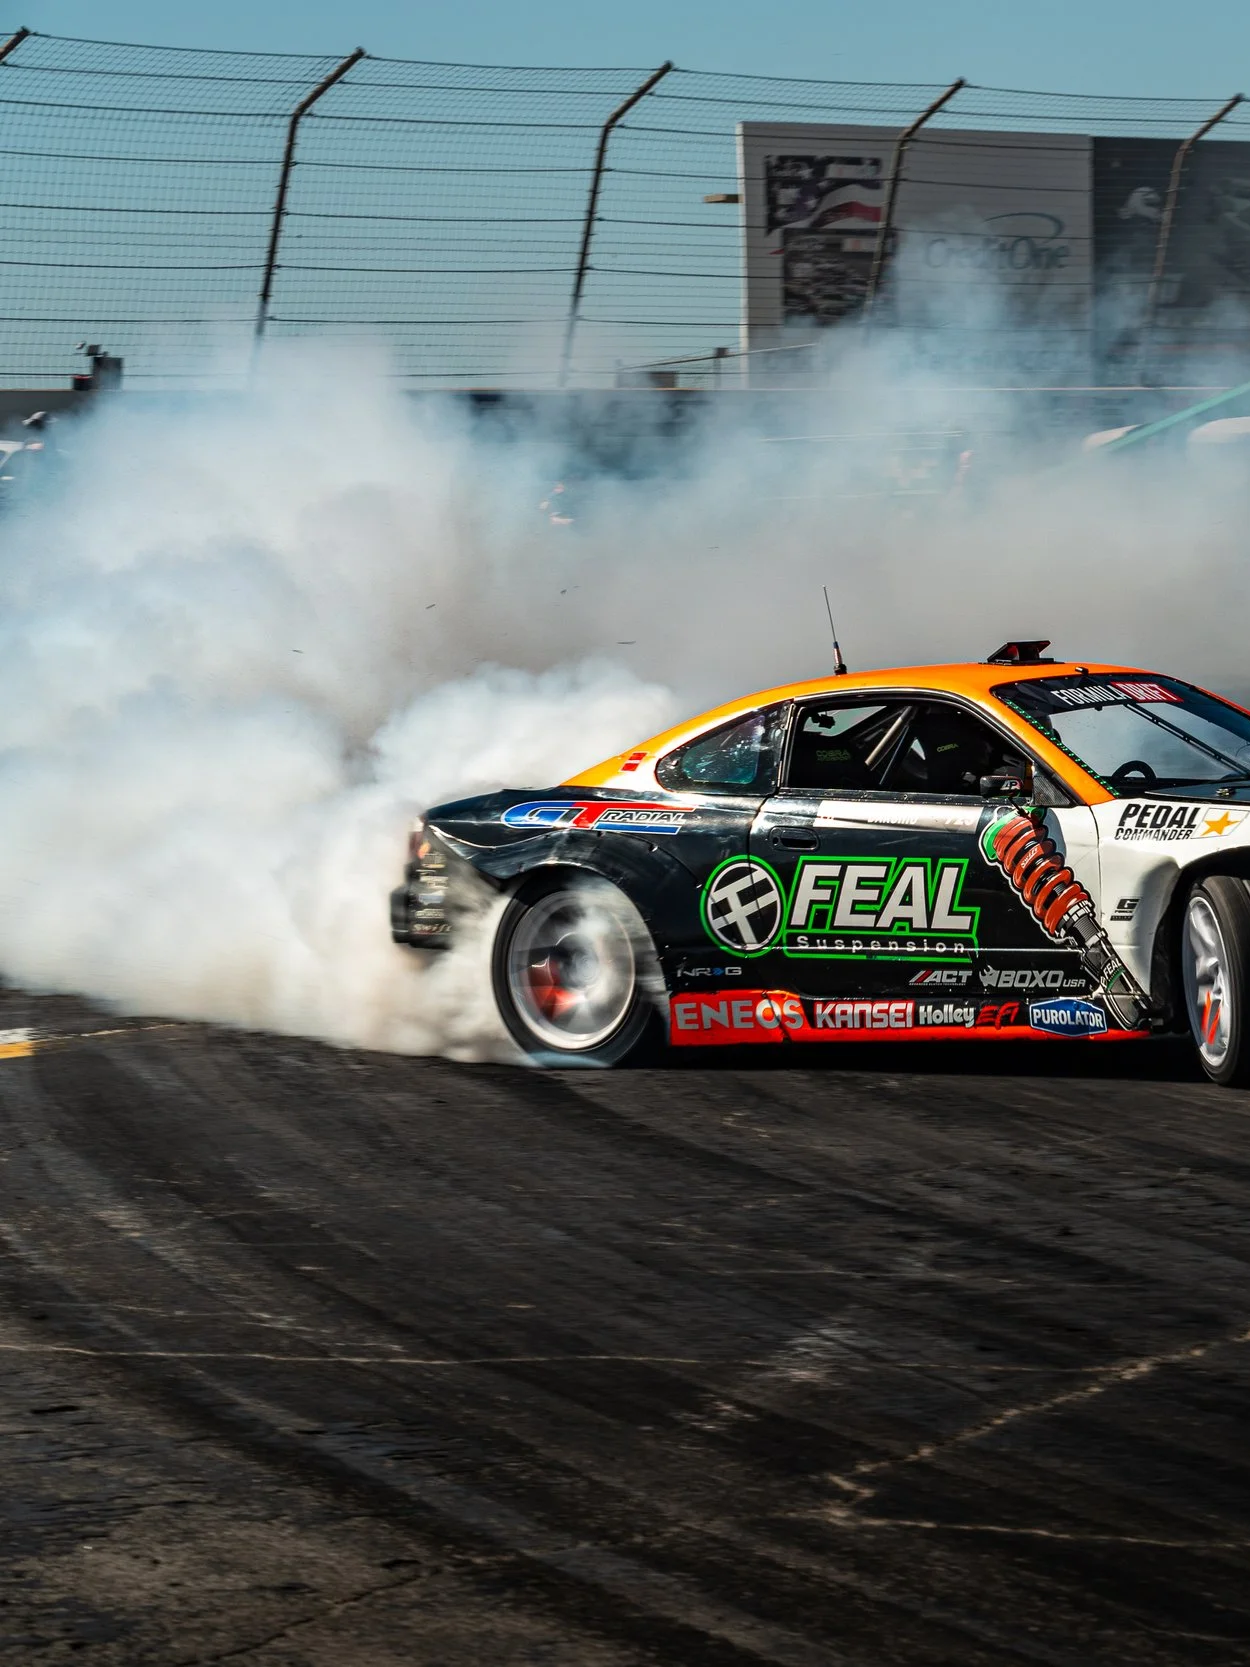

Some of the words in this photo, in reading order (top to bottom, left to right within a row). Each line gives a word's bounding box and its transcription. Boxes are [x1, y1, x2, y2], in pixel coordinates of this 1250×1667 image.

[1051, 684, 1131, 706] FORMULA
[1120, 682, 1180, 703] DRIFT
[603, 810, 688, 824] RADIAL
[1118, 803, 1202, 829] PEDAL
[1114, 828, 1192, 841] COMMANDER
[790, 864, 972, 930] FEAL
[796, 935, 965, 954] Suspension
[917, 970, 973, 984] ACT
[998, 970, 1064, 988] BOXO
[1063, 978, 1086, 988] USA
[674, 999, 805, 1030] ENEOS
[814, 1002, 914, 1029] KANSEI
[919, 1004, 976, 1028] Holley
[1033, 1008, 1103, 1028] PUROLATOR
